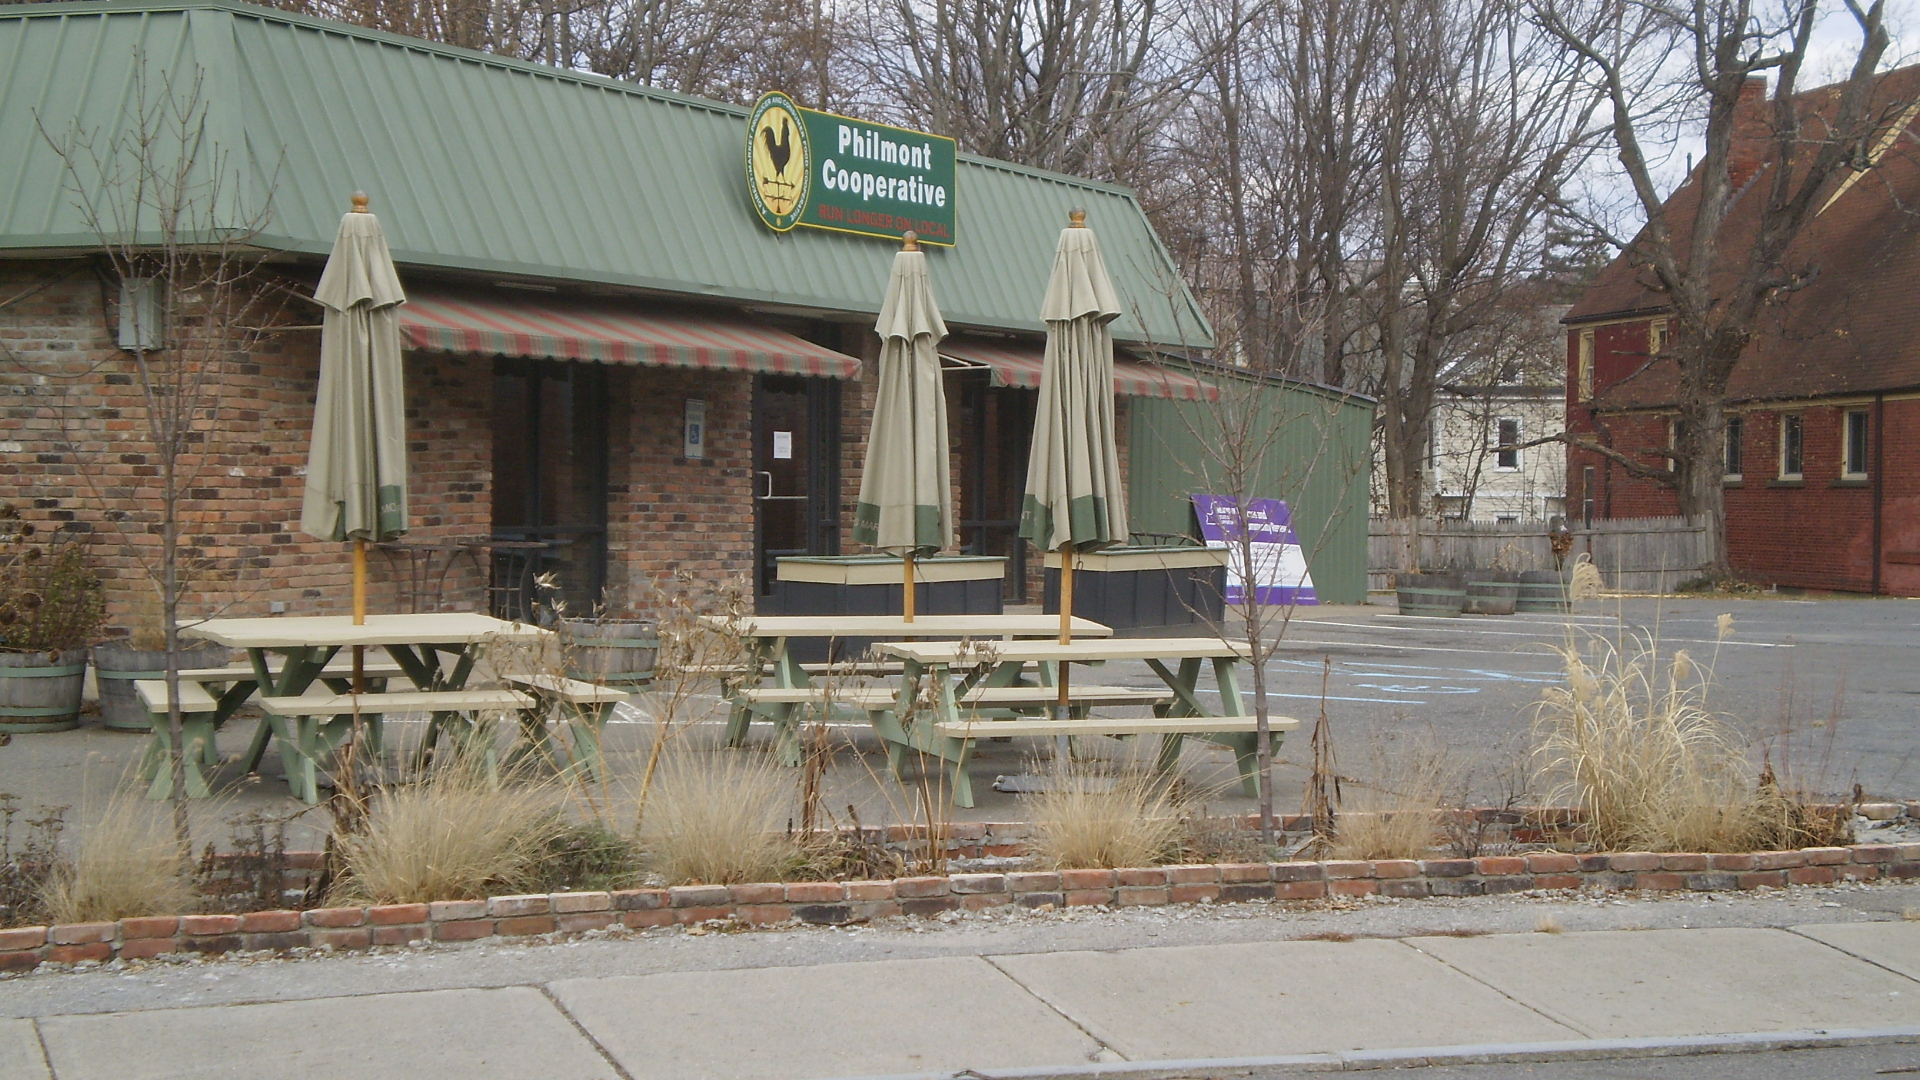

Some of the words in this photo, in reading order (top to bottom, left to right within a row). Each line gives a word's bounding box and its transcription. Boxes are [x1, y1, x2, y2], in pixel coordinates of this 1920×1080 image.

[751, 98, 771, 132] PRODUCER
[782, 99, 804, 138] CONSUMER
[838, 124, 931, 170] Philmont
[789, 169, 809, 221] COOPERATIVE
[822, 158, 946, 207] Cooperative
[818, 203, 843, 221] RUN
[846, 208, 893, 229] LONGER
[895, 215, 912, 232] ON
[915, 219, 951, 239] LOCAL
